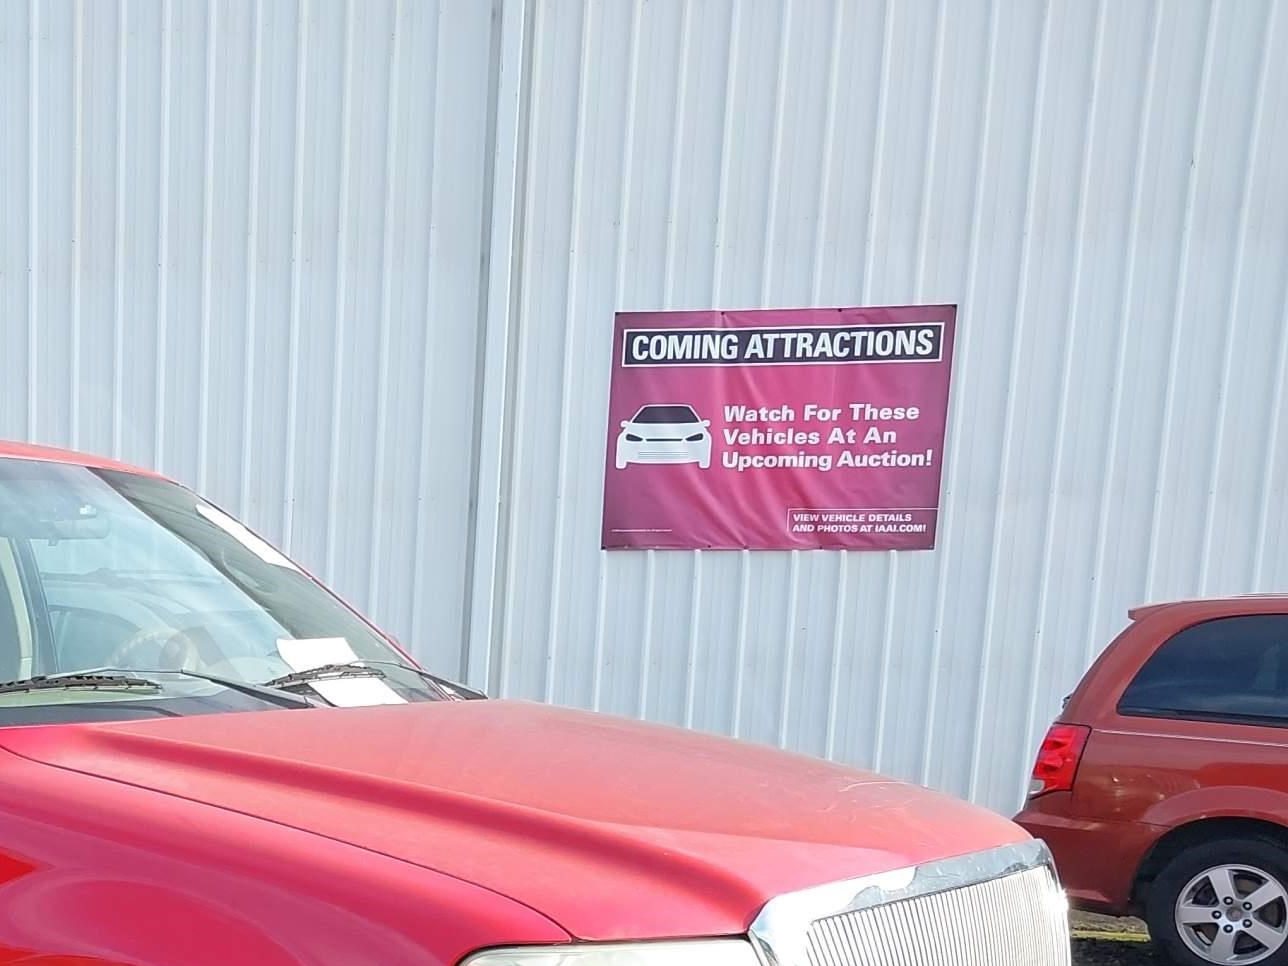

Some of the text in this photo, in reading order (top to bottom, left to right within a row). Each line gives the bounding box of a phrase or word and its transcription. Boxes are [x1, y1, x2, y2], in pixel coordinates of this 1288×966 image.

[632, 329, 933, 360] COMING ATTRACTIONS
[724, 403, 920, 422] Watch For These
[723, 426, 897, 445] Vehicles At An
[722, 450, 933, 471] Upcoming Auction!
[792, 513, 913, 522] VIEW VEHICLE DETAILS
[792, 524, 926, 533] AND PHOTOS AT IAAI.COM!
